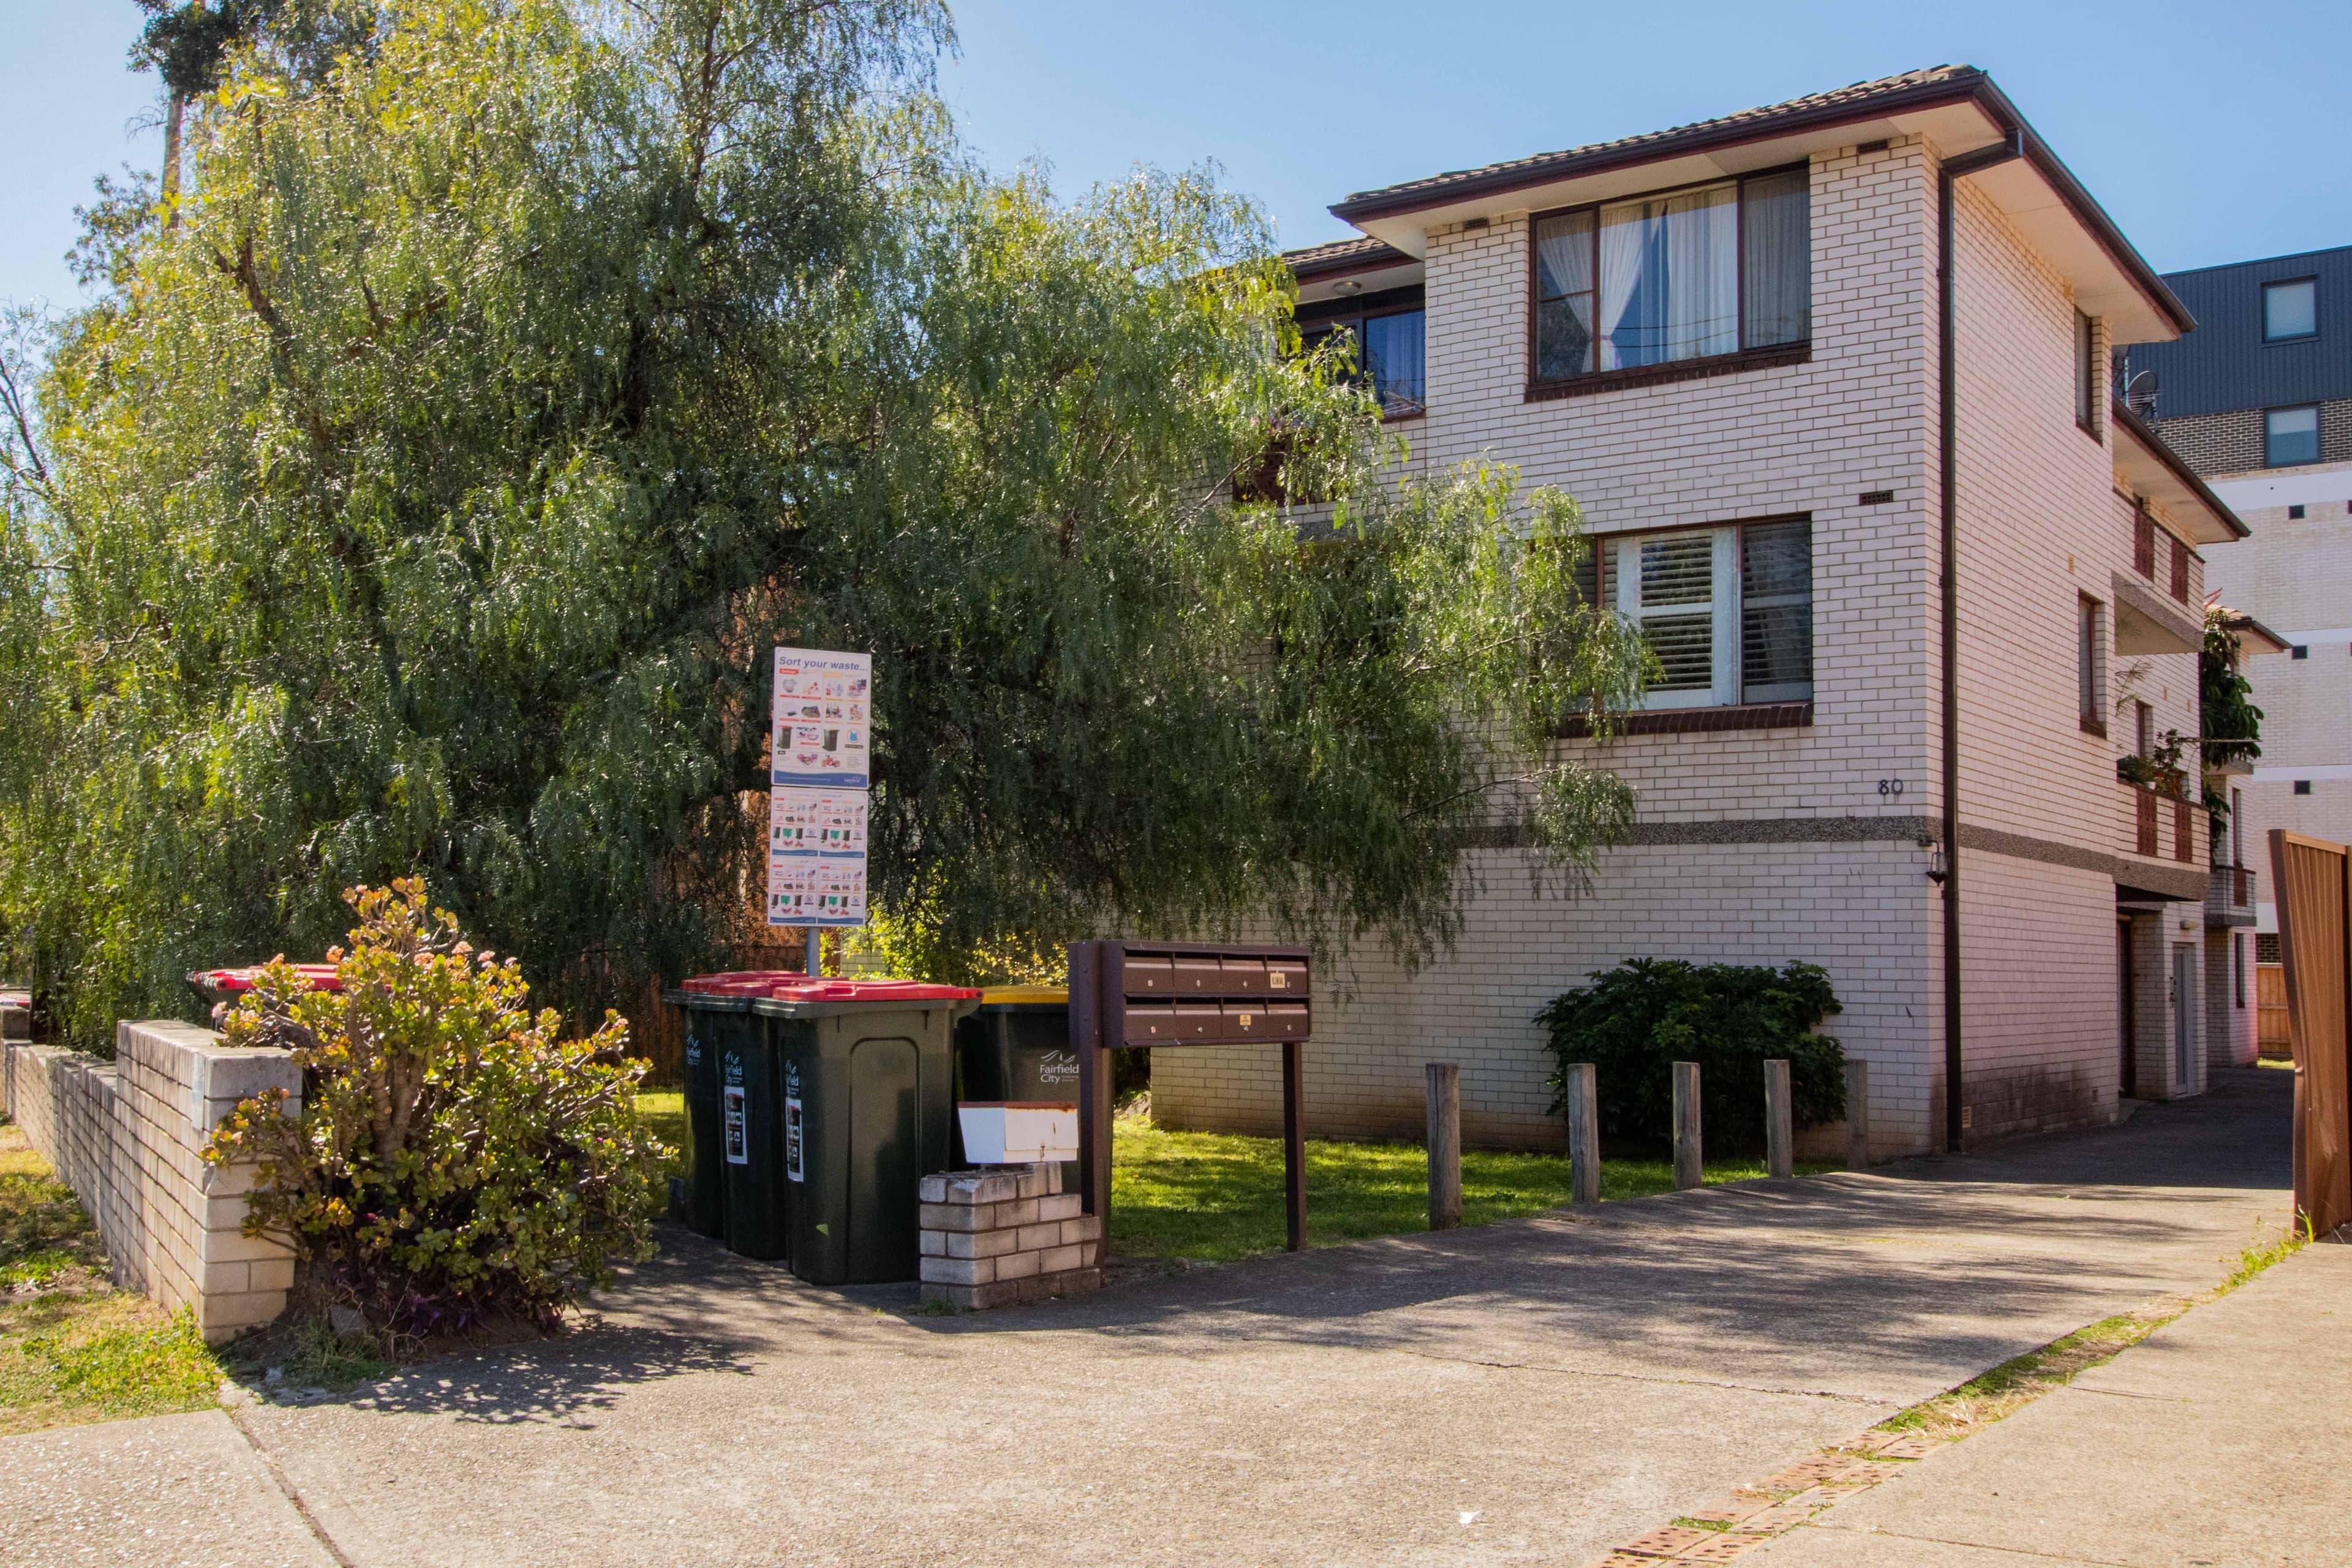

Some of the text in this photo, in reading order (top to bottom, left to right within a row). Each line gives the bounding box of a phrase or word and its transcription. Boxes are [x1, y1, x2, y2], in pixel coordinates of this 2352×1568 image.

[779, 657, 801, 666] Sort
[831, 662, 868, 671] waste...
[1879, 779, 1903, 795] 80
[1040, 1063, 1079, 1074] Fairfield
[1041, 1074, 1060, 1084] City
